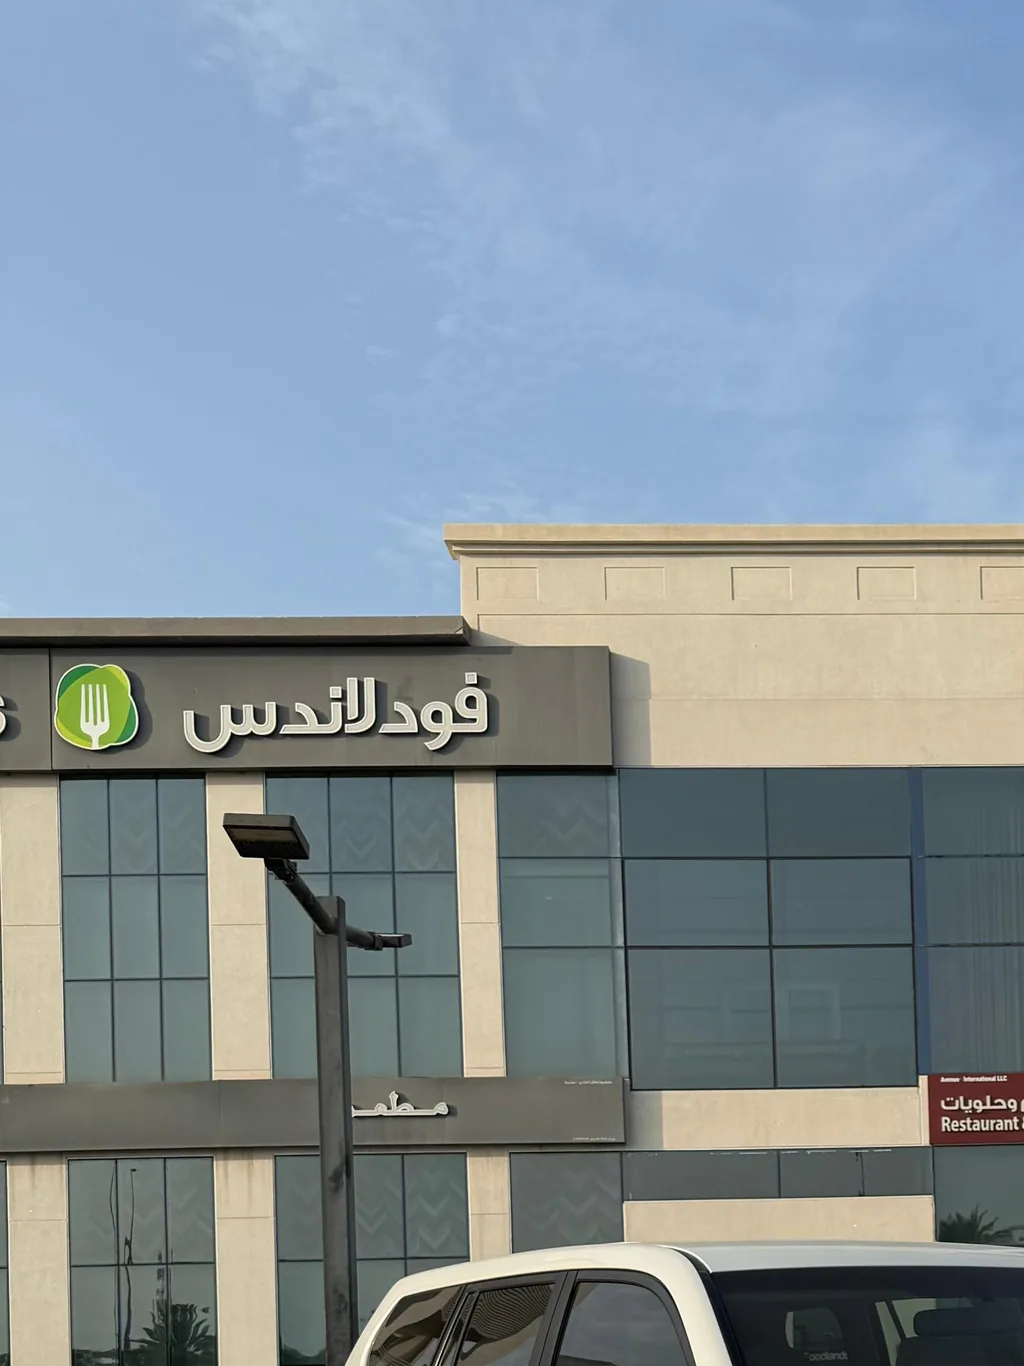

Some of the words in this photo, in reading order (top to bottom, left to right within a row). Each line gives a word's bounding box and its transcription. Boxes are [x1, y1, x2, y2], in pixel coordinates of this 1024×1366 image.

[182, 671, 488, 753] فودلاندس
[351, 1091, 449, 1118] مطع
[940, 1095, 1018, 1113] وحلويات
[941, 1115, 1020, 1132] Restaurant
